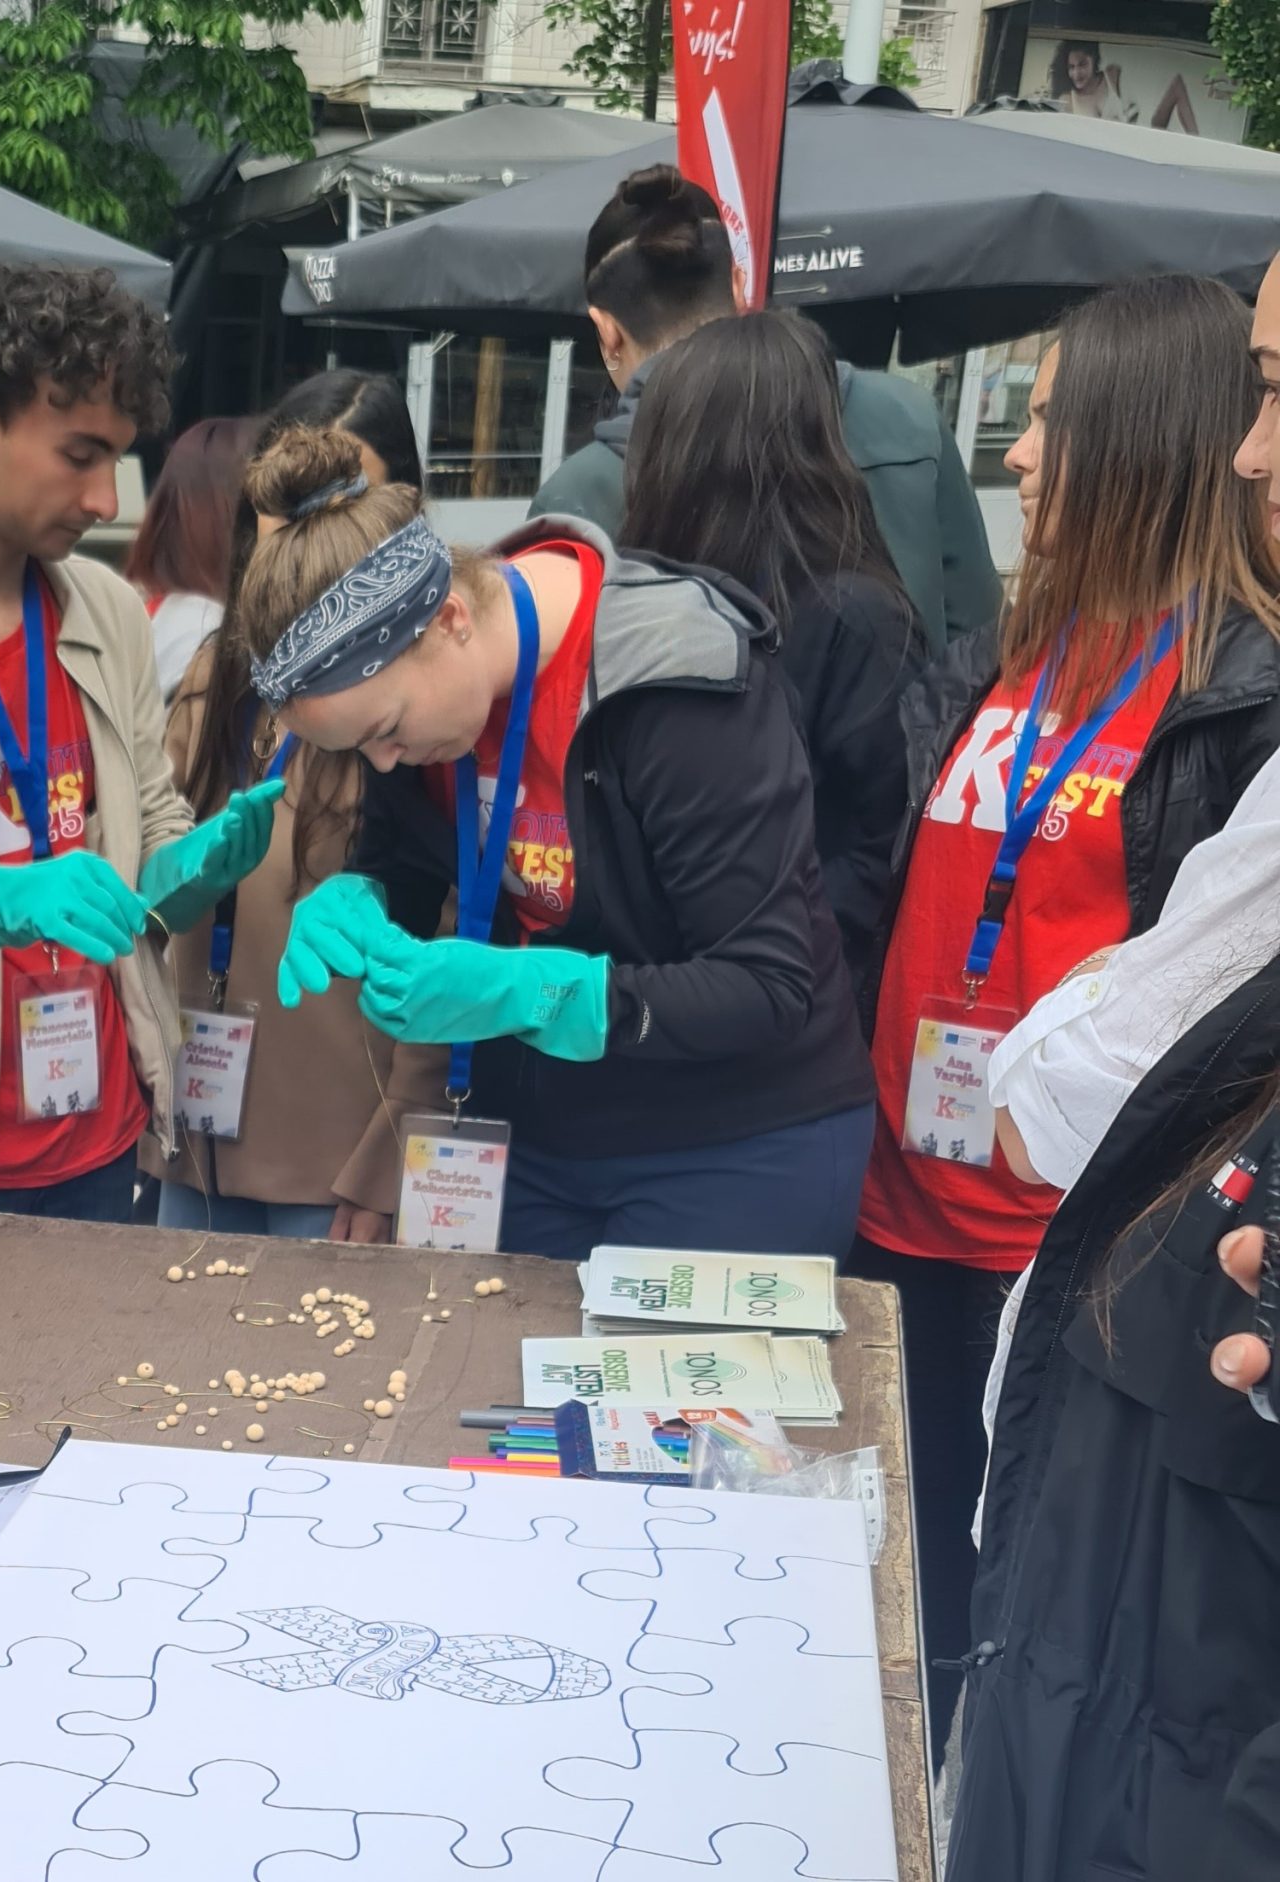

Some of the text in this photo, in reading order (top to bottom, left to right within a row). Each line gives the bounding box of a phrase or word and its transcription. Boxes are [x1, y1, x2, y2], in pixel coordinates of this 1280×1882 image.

[774, 246, 864, 274] MES ALIVE
[1024, 766, 1126, 818] FST
[507, 841, 573, 884] FES
[946, 1055, 972, 1072] Ana
[426, 1169, 481, 1185] Christa
[610, 1275, 640, 1299] ACT
[638, 1279, 669, 1312] LISTEN
[667, 1265, 695, 1309] OBSERVE
[749, 1272, 778, 1317] IONOS
[541, 1363, 574, 1386] ACT
[573, 1364, 604, 1398] LISTEN
[602, 1349, 631, 1393] OBSERVE
[685, 1351, 723, 1396] IONOS
